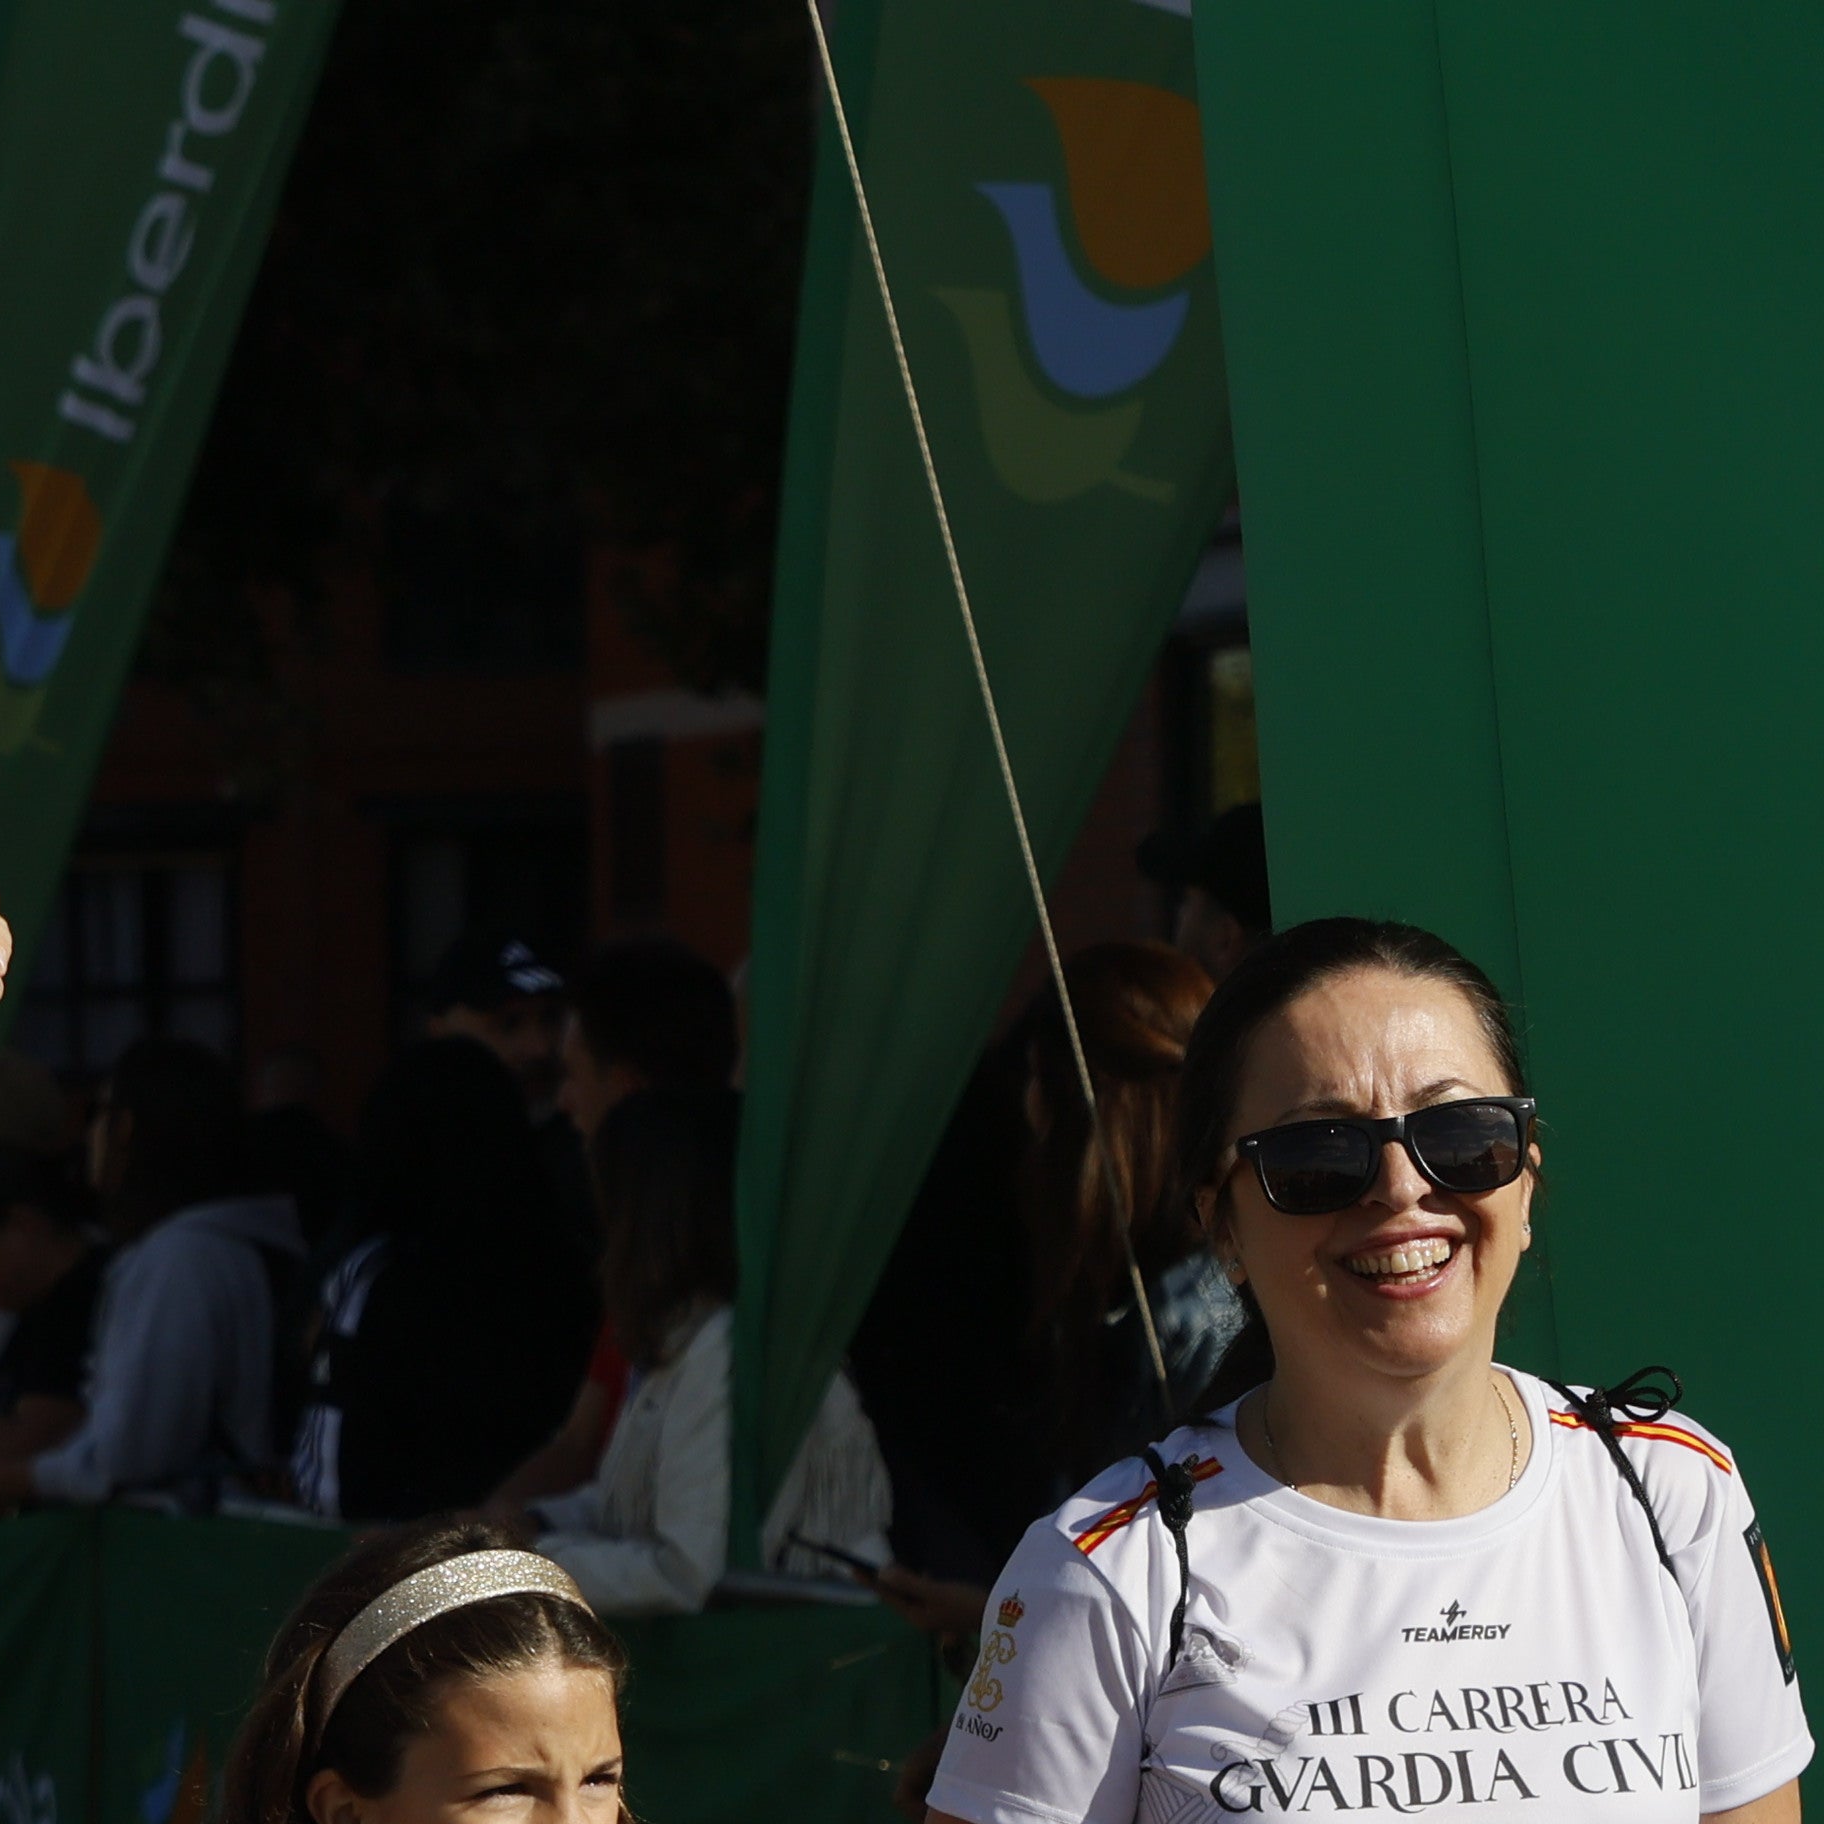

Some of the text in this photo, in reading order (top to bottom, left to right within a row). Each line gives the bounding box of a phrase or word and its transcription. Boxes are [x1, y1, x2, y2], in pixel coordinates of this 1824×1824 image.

[56, 0, 278, 443] Iberd
[1401, 1623, 1512, 1643] TEAMERGY
[1308, 1676, 1633, 1737] III CARRERA
[1209, 1749, 1540, 1815] GVARDIA
